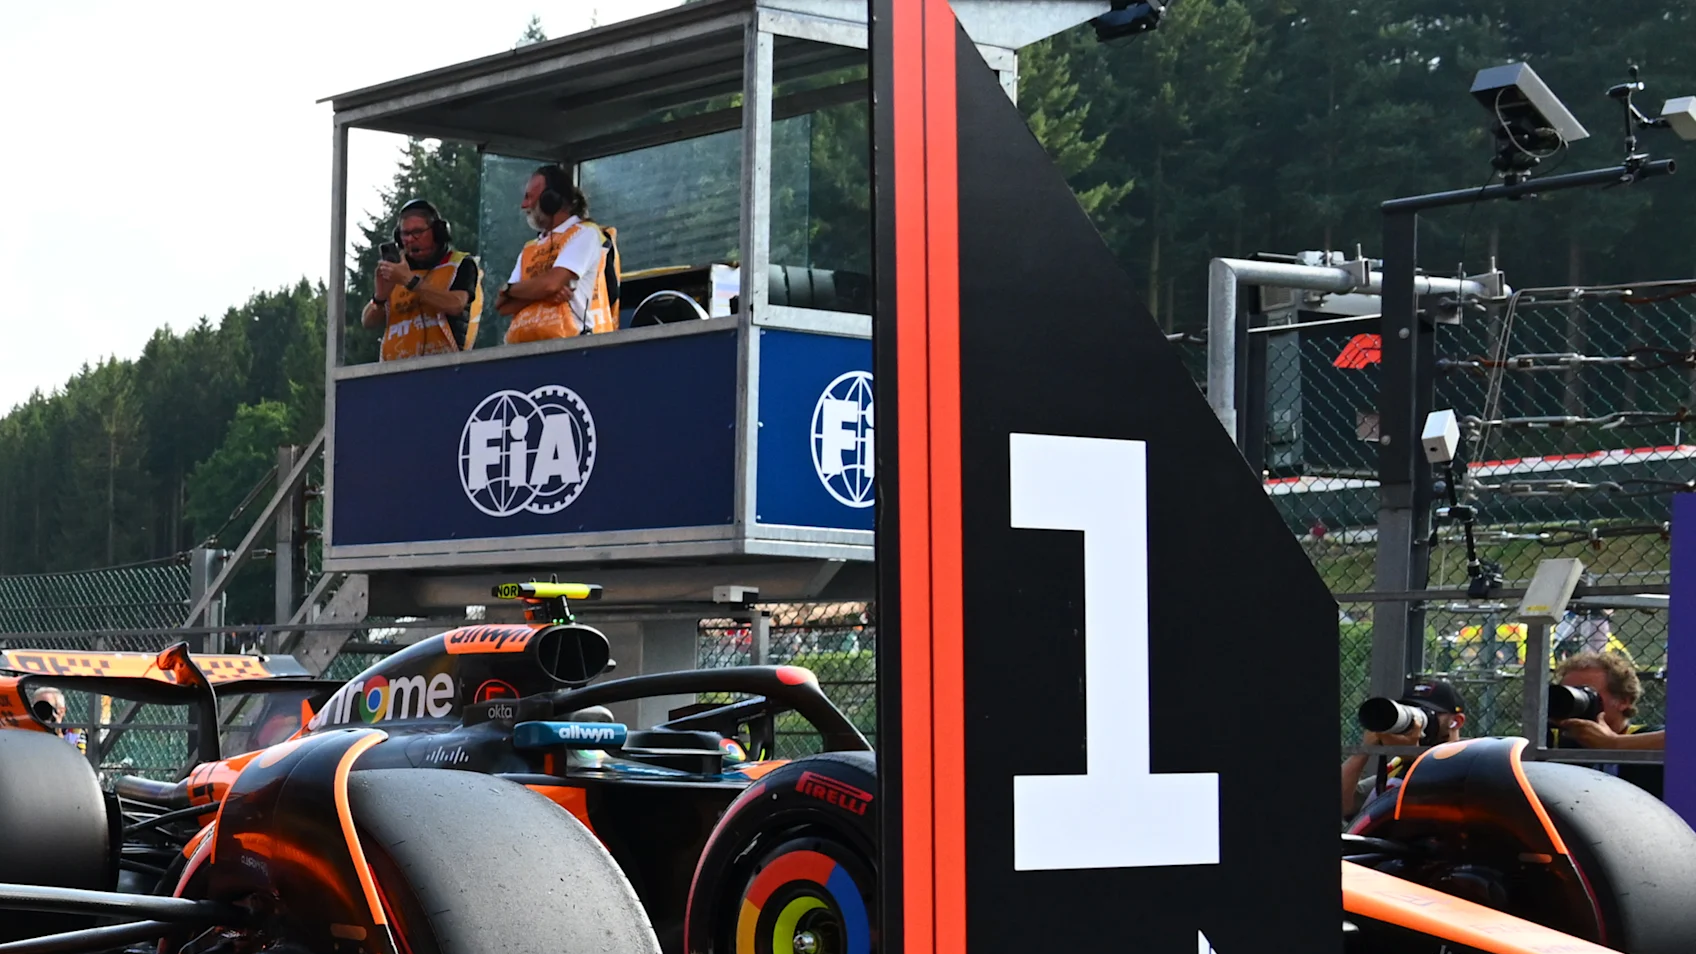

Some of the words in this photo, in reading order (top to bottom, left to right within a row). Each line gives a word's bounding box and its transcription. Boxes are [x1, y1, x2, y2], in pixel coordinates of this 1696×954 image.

[496, 585, 518, 597] NOR
[449, 623, 536, 649] allwyn
[1008, 432, 1220, 871] 1
[487, 704, 514, 721] okta
[557, 725, 615, 744] allwyn
[795, 771, 874, 816] PIRELLI
